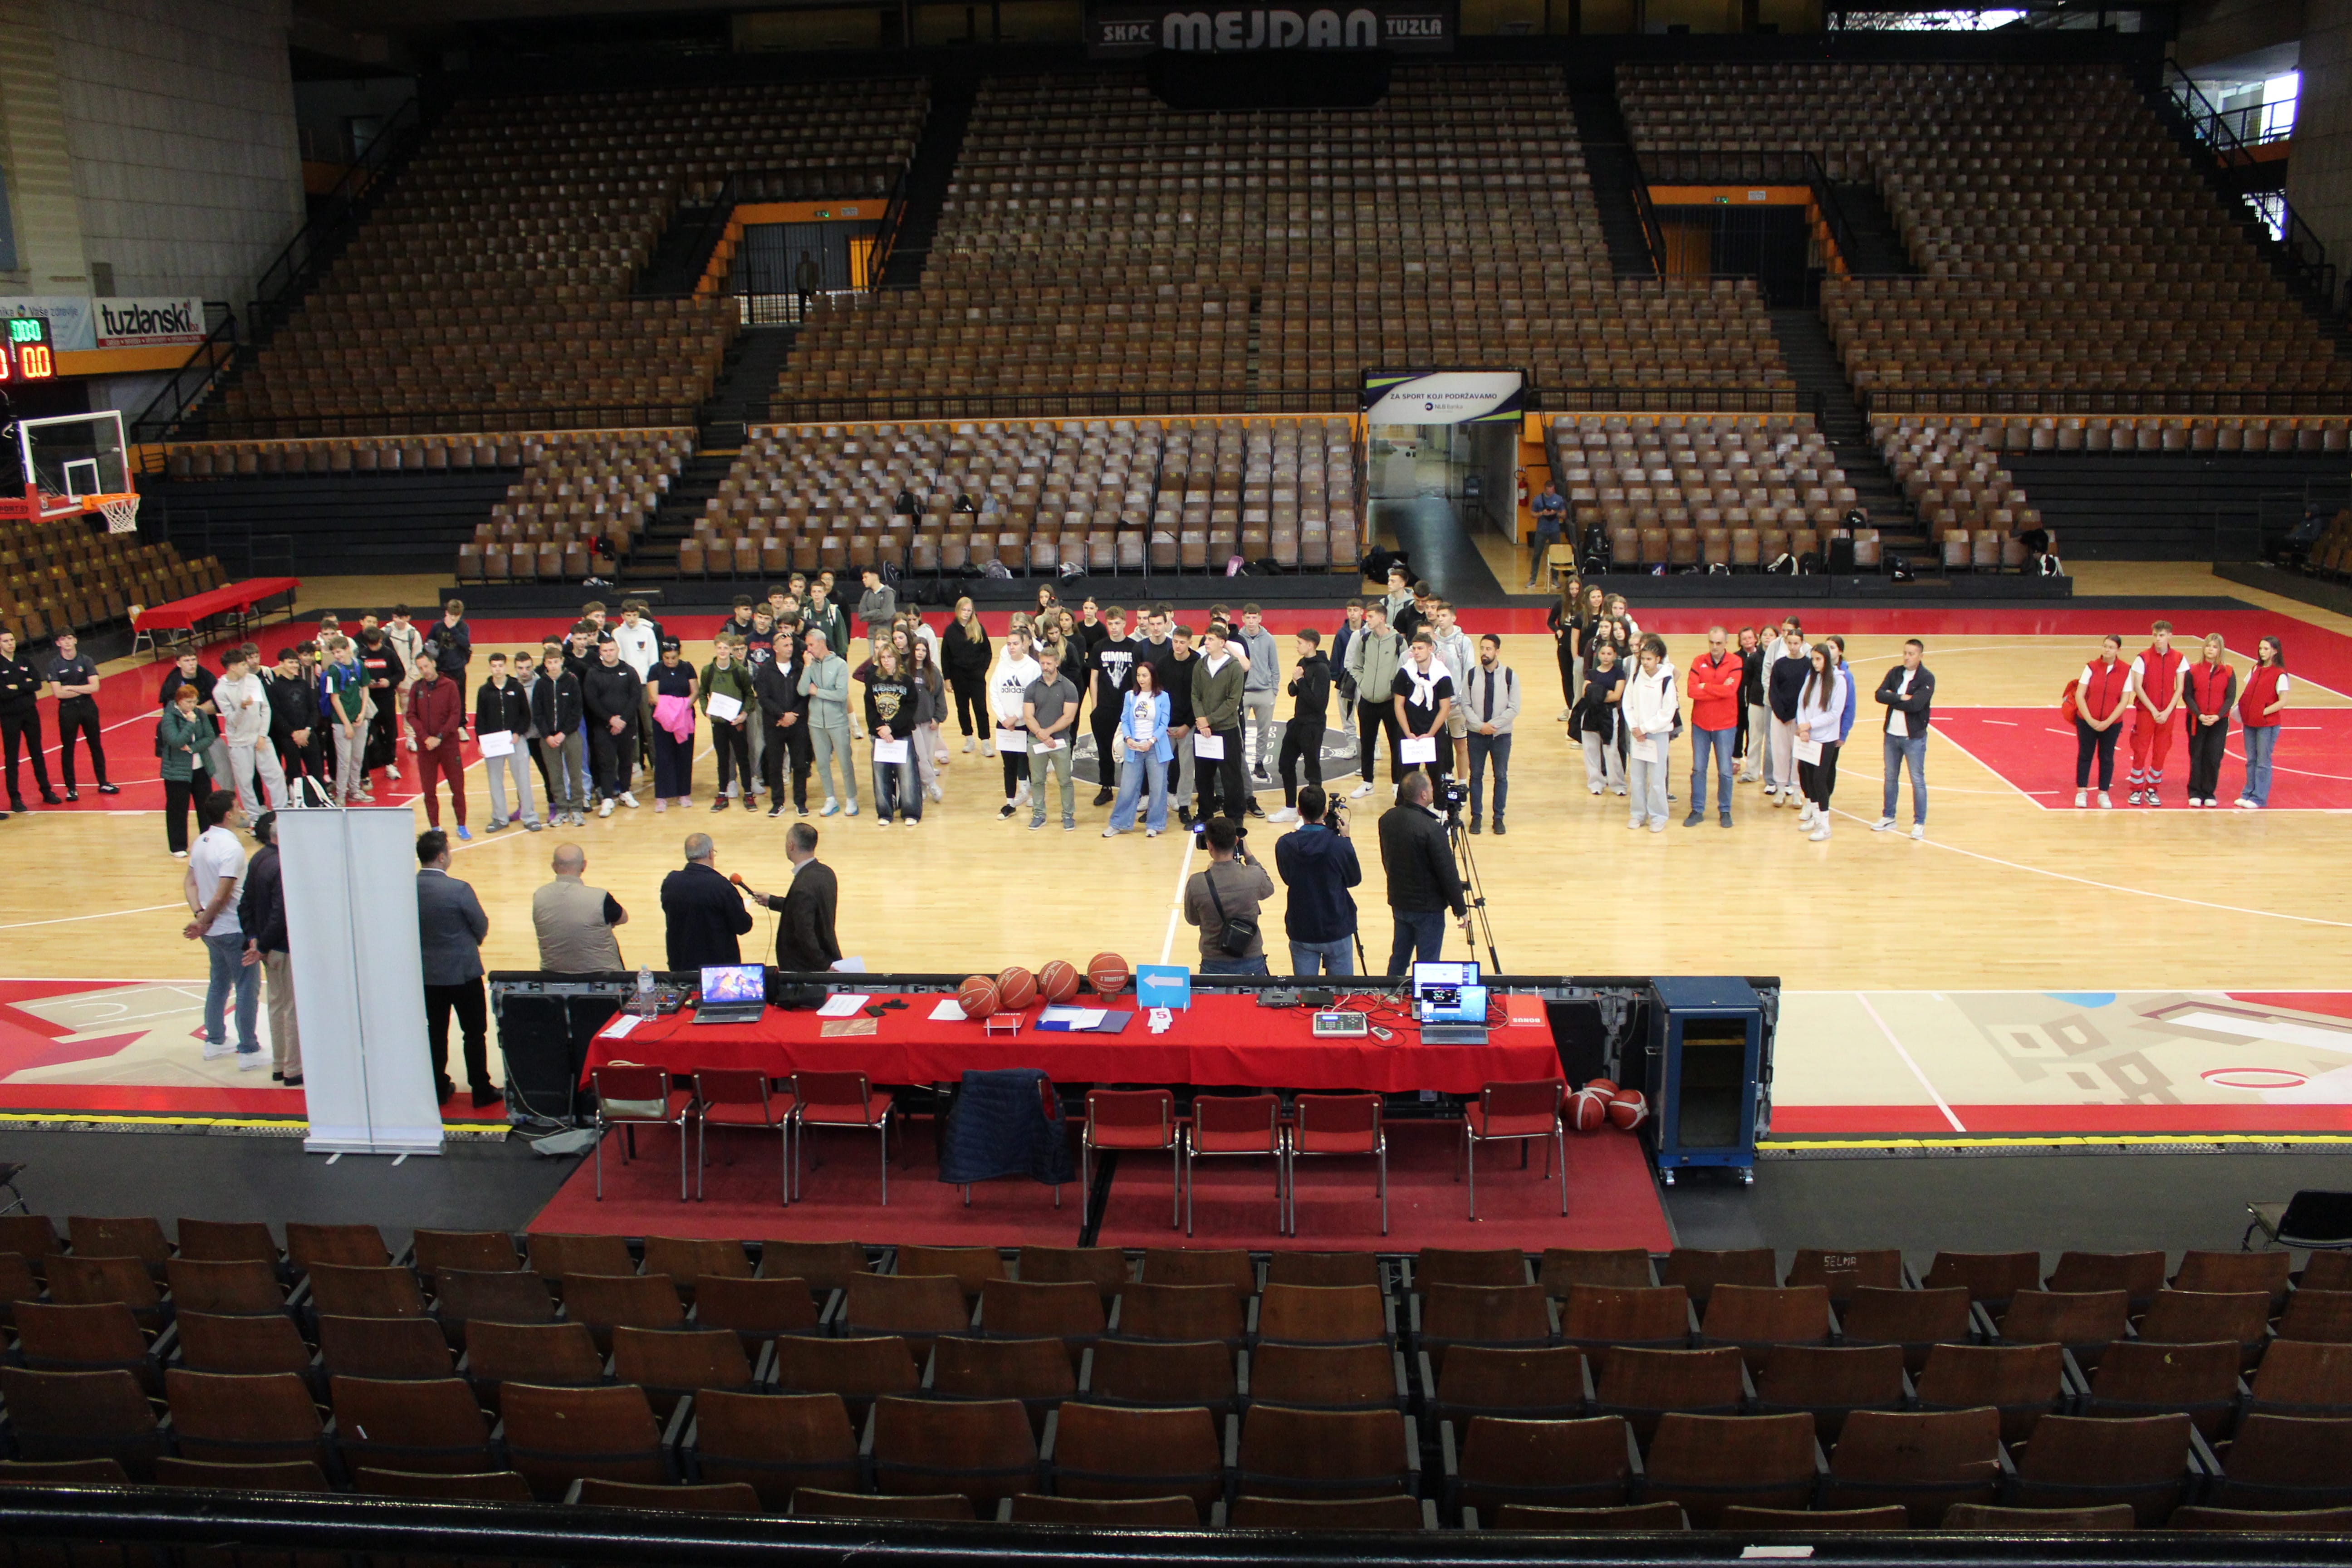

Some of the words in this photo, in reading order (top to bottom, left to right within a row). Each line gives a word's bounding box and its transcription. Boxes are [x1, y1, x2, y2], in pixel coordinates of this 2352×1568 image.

[1103, 24, 1150, 41] SKPC
[1162, 9, 1377, 50] MEJDAN
[1386, 19, 1442, 35] TUZLA
[1100, 651, 1133, 662] GIMME
[1824, 1255, 1857, 1267] SELMA
